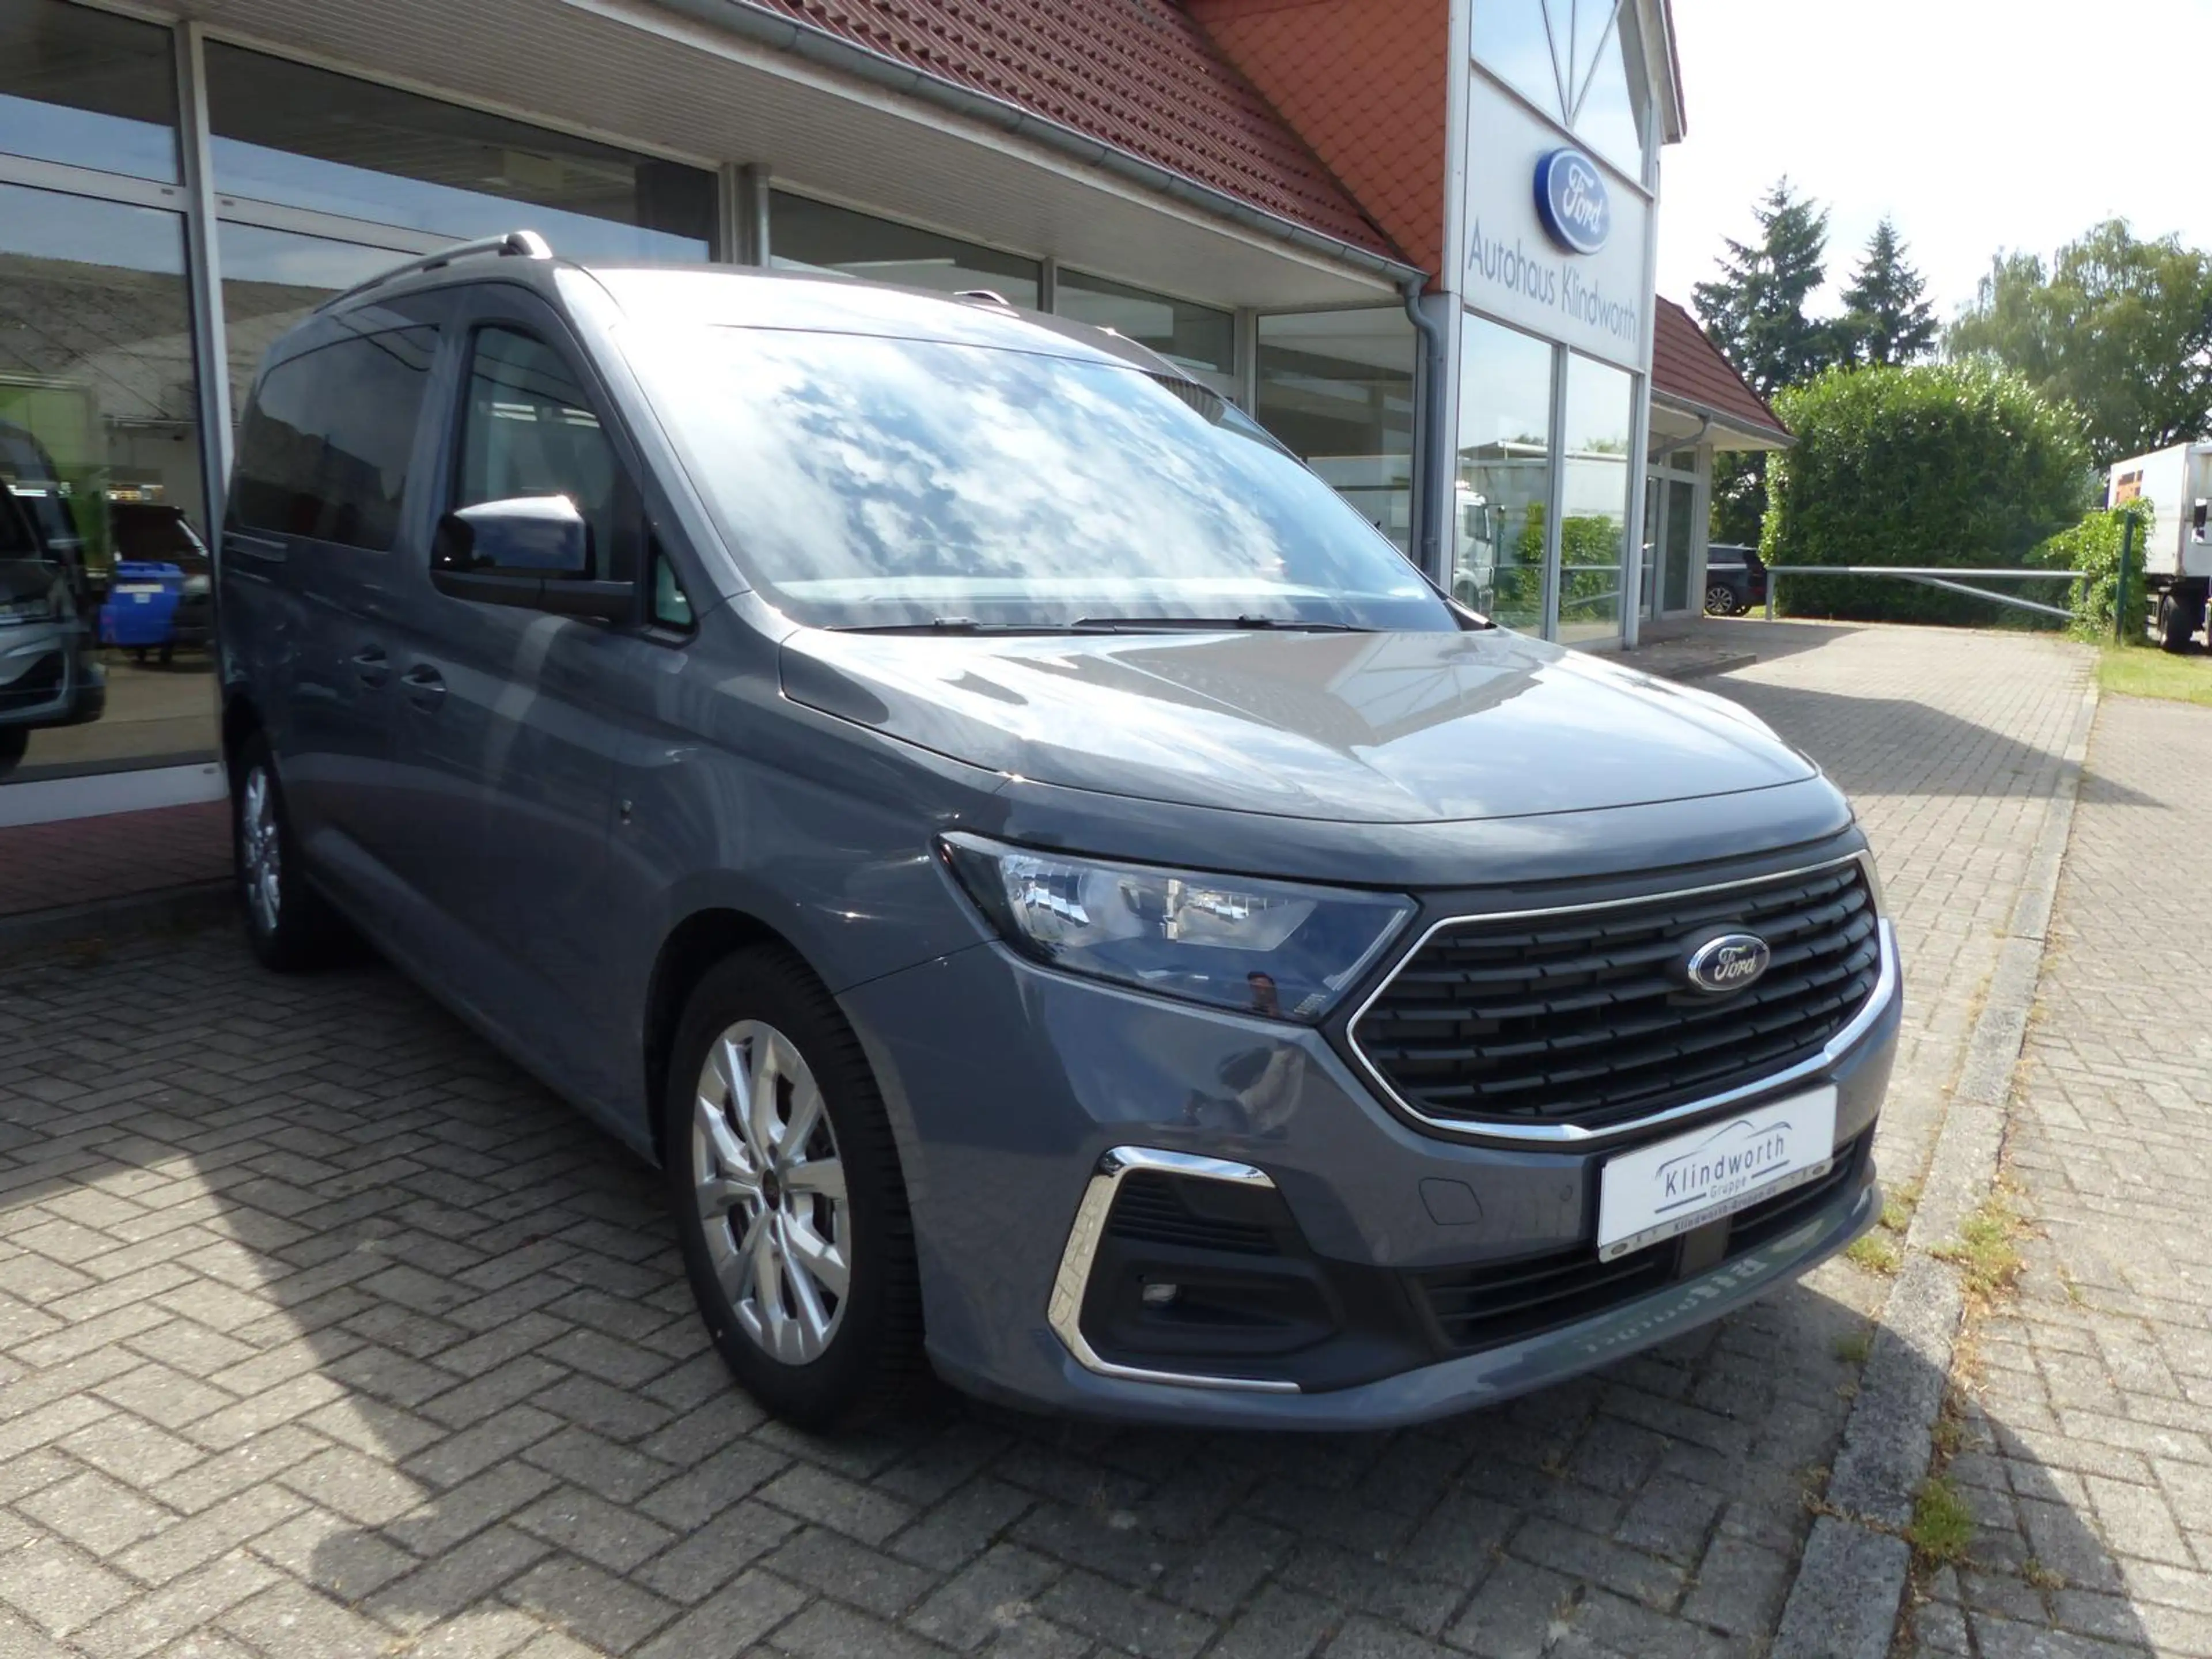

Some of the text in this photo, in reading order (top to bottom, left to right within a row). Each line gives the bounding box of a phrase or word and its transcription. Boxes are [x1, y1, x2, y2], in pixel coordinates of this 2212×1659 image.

[1562, 164, 1603, 234] Ford
[1468, 215, 1636, 343] Autohaus Klindworth
[1714, 945, 1757, 980] Ford
[1665, 1134, 1785, 1198] Klindworth
[1709, 1176, 1747, 1198] Gruppe
